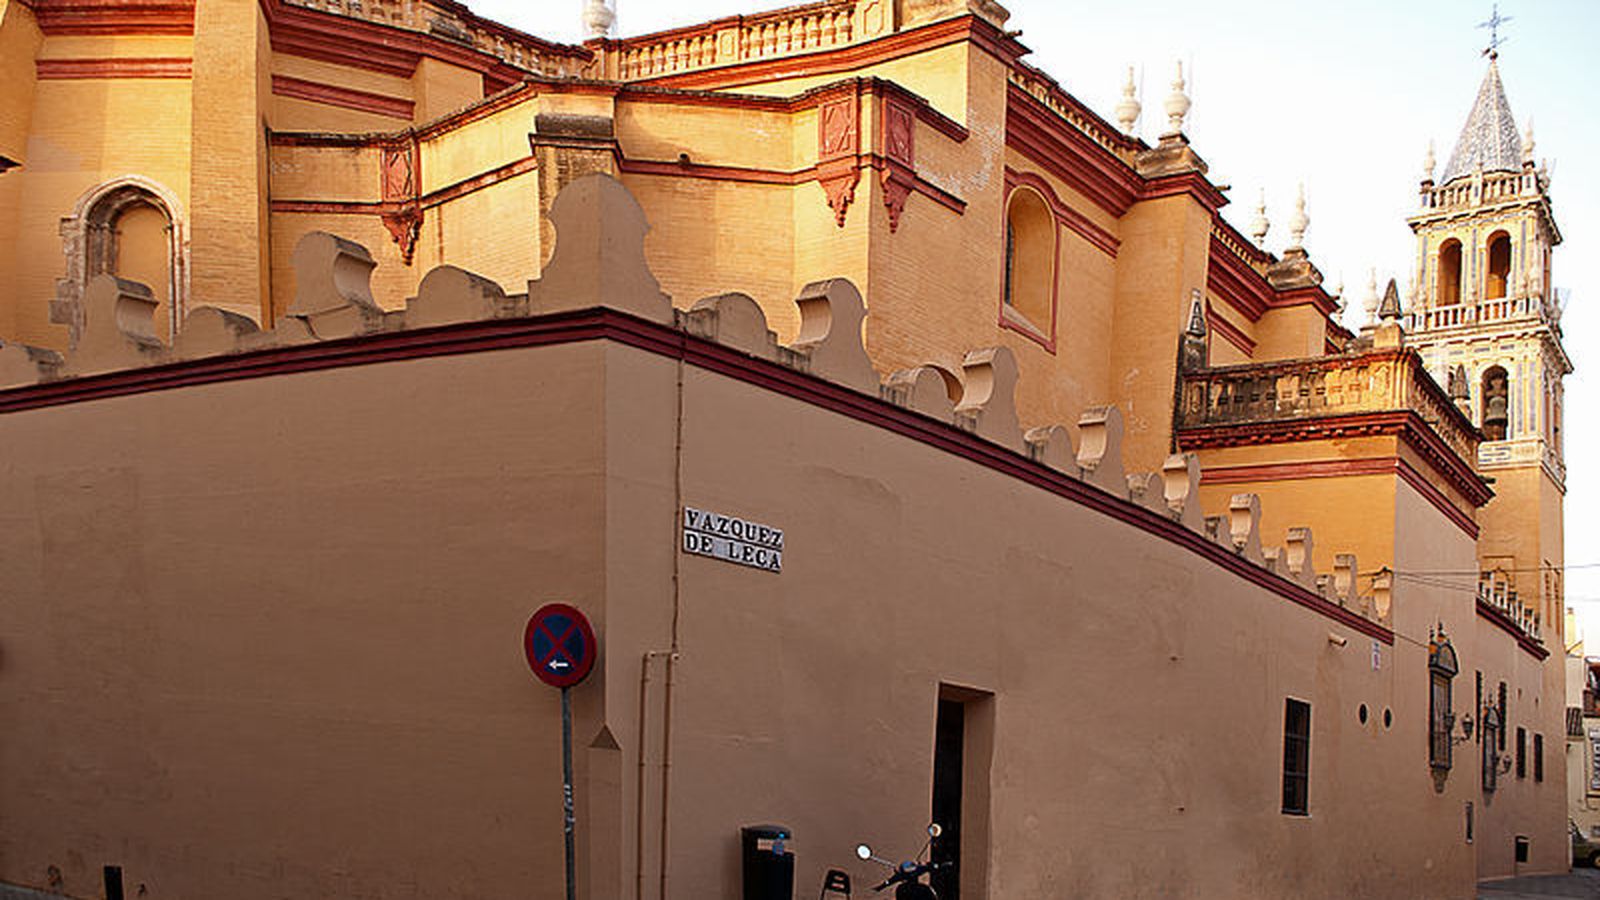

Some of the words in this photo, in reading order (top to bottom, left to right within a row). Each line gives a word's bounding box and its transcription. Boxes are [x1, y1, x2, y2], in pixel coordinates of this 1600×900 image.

[687, 509, 782, 548] VAZQUEZ
[686, 533, 713, 553] DE
[729, 542, 780, 569] LECA
